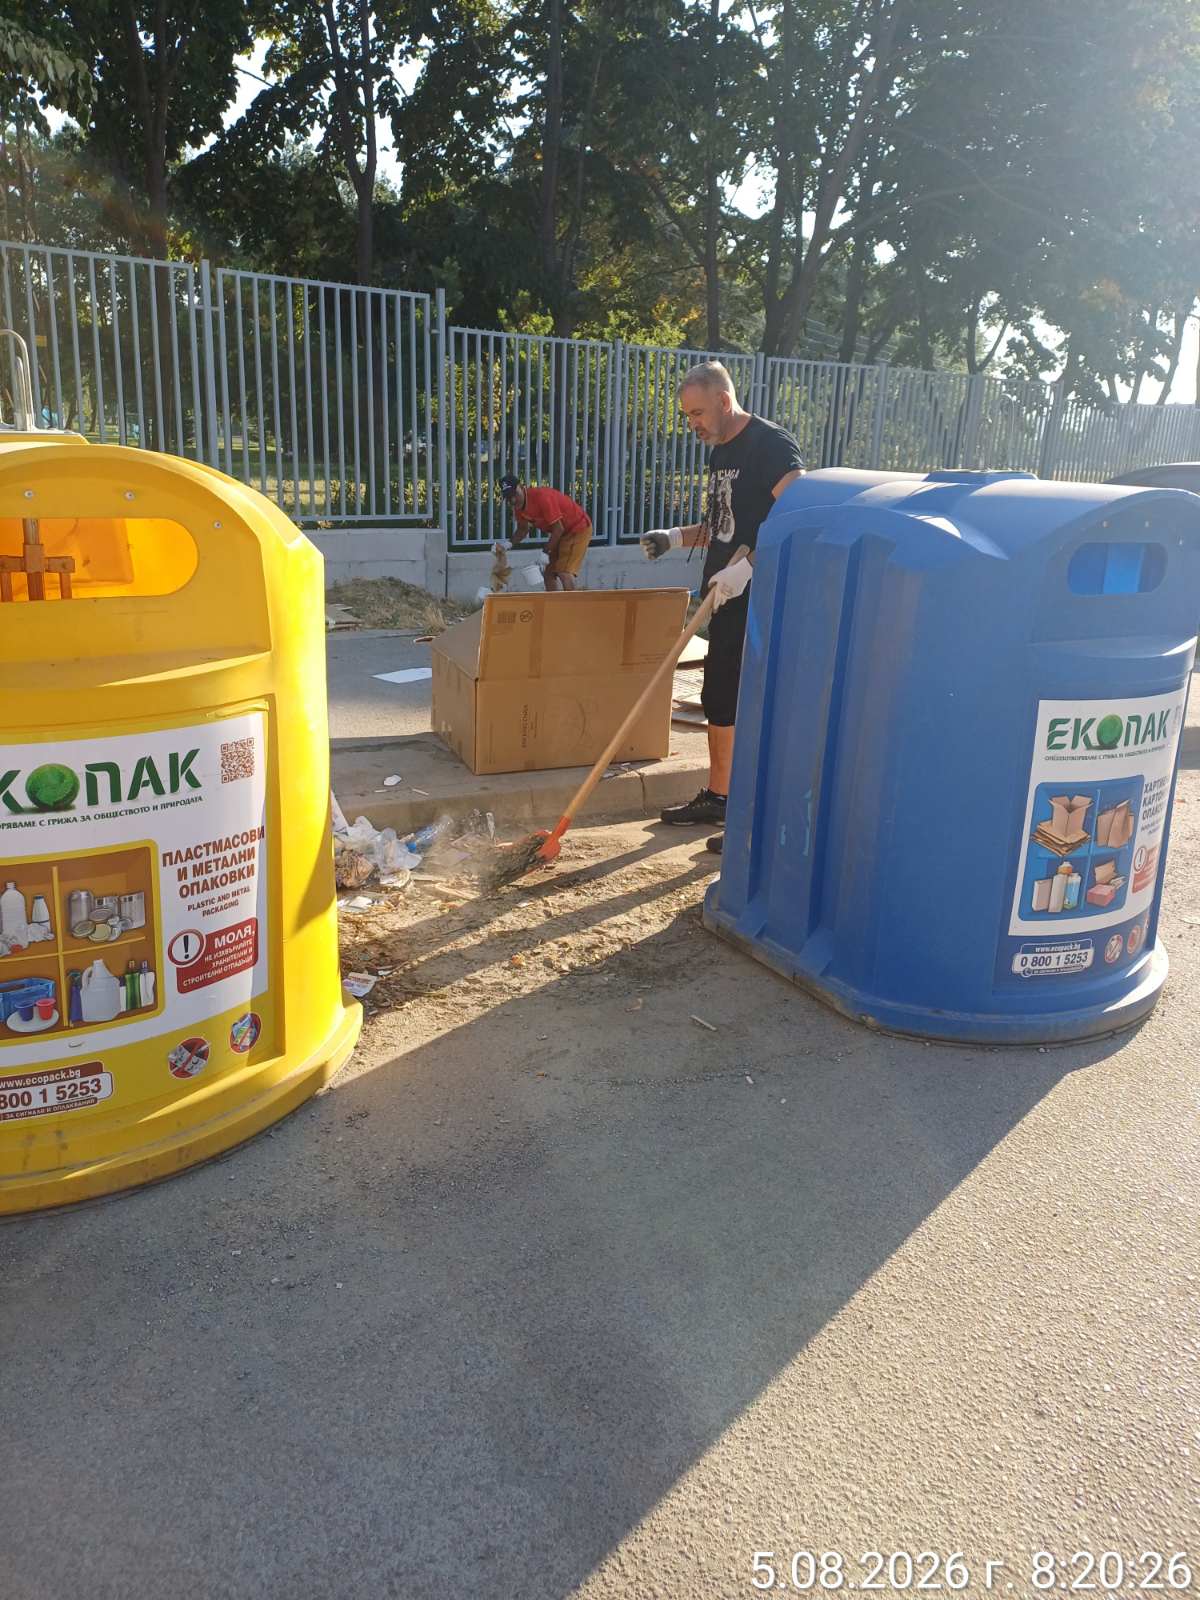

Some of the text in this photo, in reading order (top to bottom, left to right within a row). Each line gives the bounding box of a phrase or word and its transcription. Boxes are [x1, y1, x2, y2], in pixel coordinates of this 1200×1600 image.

[1046, 709, 1172, 750] ЕКОПАК
[0, 820, 37, 830] РЯВАМЕ
[48, 817, 77, 826] ГРИЖА
[94, 806, 150, 820] ОБЩЕСТВОТО
[160, 796, 203, 810] ПРИРОДАТА
[162, 825, 265, 867] ПЛАСТМАСОВИ
[177, 846, 255, 882] И МЕТАЛНИ
[179, 863, 255, 899] ОПАКОВКИ
[187, 885, 250, 911] PLASTIC AND METAL
[202, 899, 239, 917] PACKAGING
[214, 925, 255, 949] МОЛЯ,
[1020, 951, 1088, 967] 0 800 1 5253
[0, 1069, 81, 1088] www.ecopack.bg
[39, 1088, 48, 1104] 1
[56, 1078, 102, 1100] 5253
